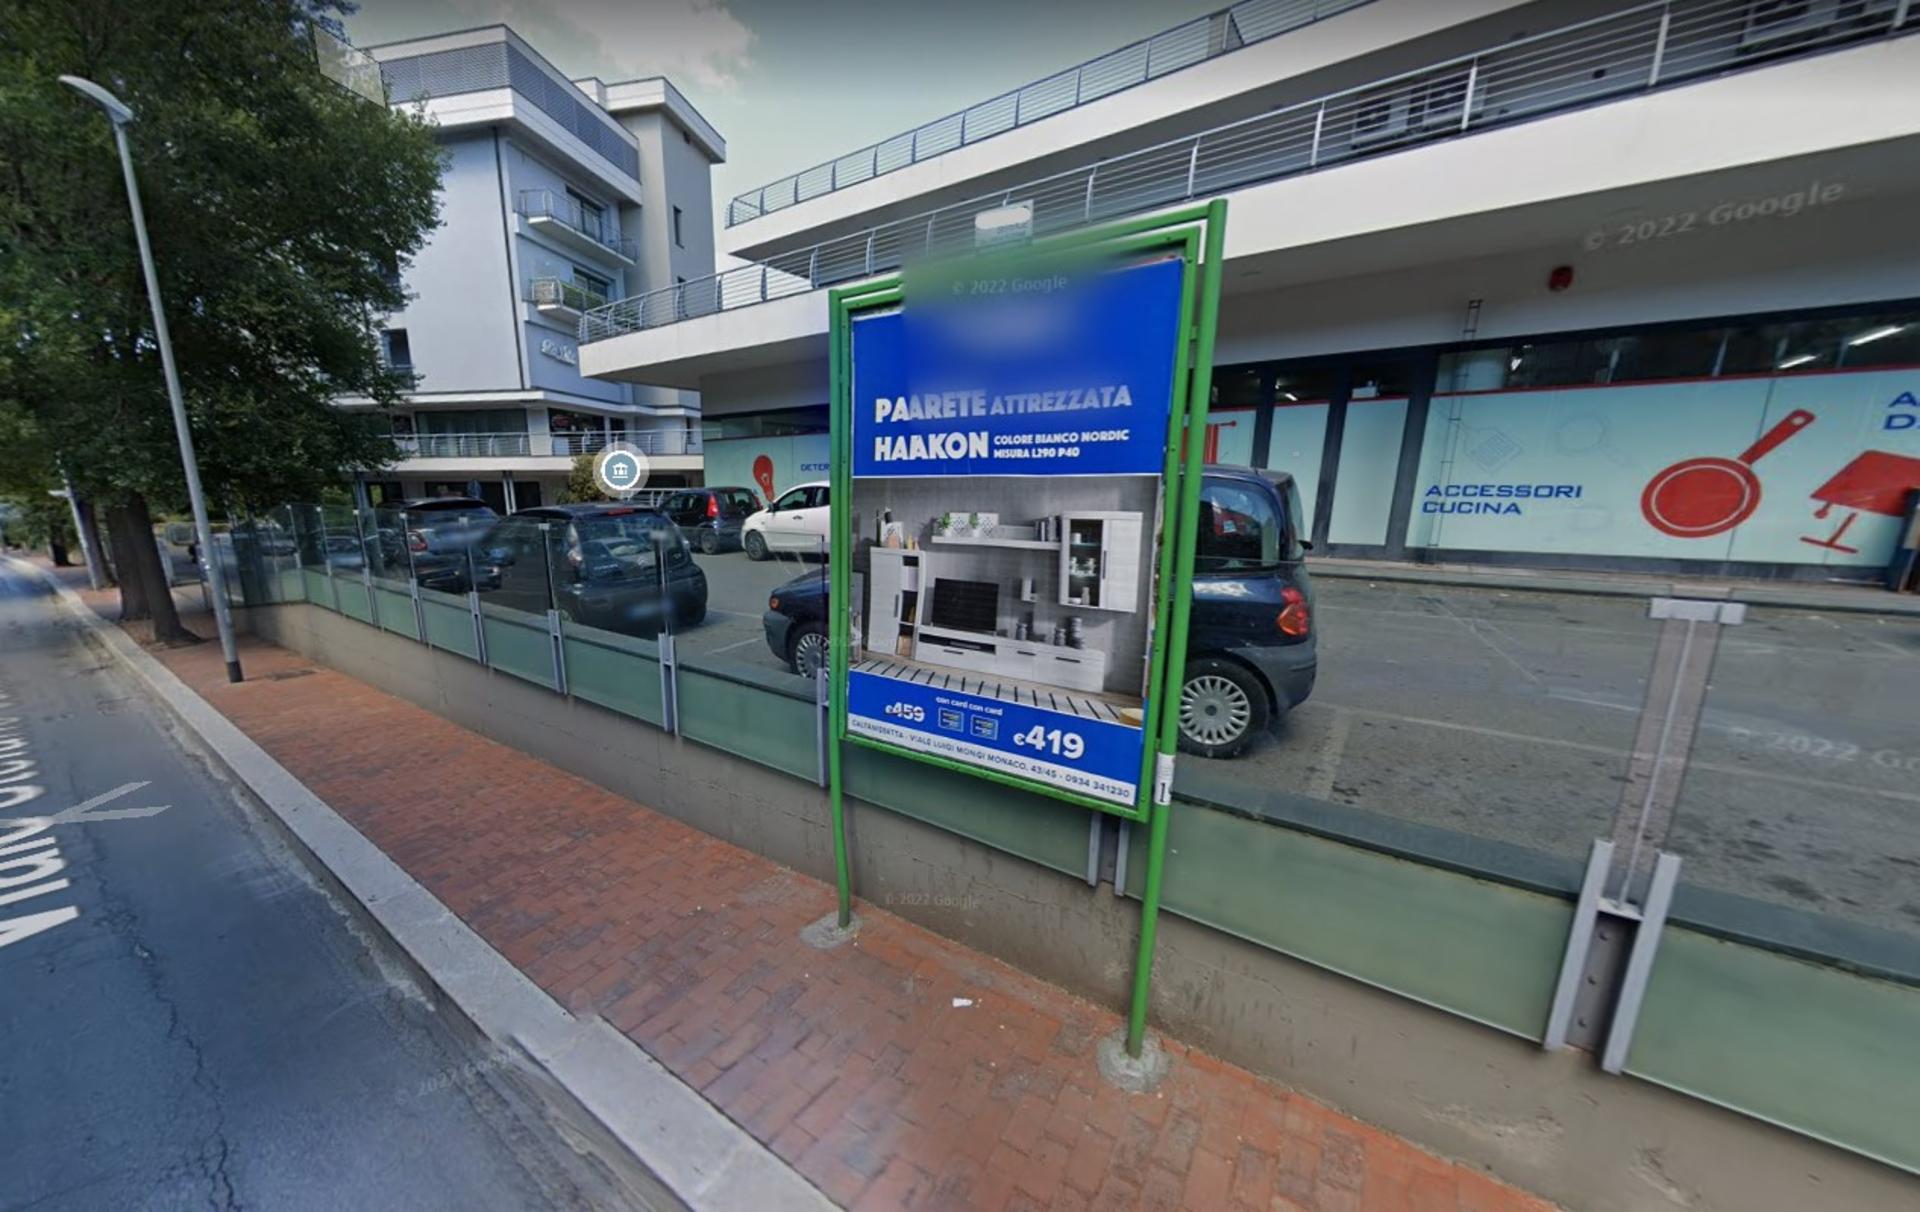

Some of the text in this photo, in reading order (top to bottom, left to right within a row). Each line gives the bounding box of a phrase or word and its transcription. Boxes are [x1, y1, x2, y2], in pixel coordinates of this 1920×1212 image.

[990, 385, 1132, 416] ATTREZZATA
[994, 429, 1131, 445] COLORE BIANCO NORDIC
[875, 431, 989, 461] HAAKON
[993, 447, 1081, 459] MISURA L290 P40
[1425, 484, 1583, 498] ACCESSORI
[1422, 501, 1522, 515] CUCINA
[936, 696, 950, 704] con
[951, 700, 968, 709] card
[969, 703, 983, 712] con
[909, 734, 931, 746] VIALE
[933, 739, 955, 751] LUIGI
[1031, 764, 1057, 779] 43/45
[1065, 773, 1090, 787] 0934
[1093, 779, 1130, 798] 341230
